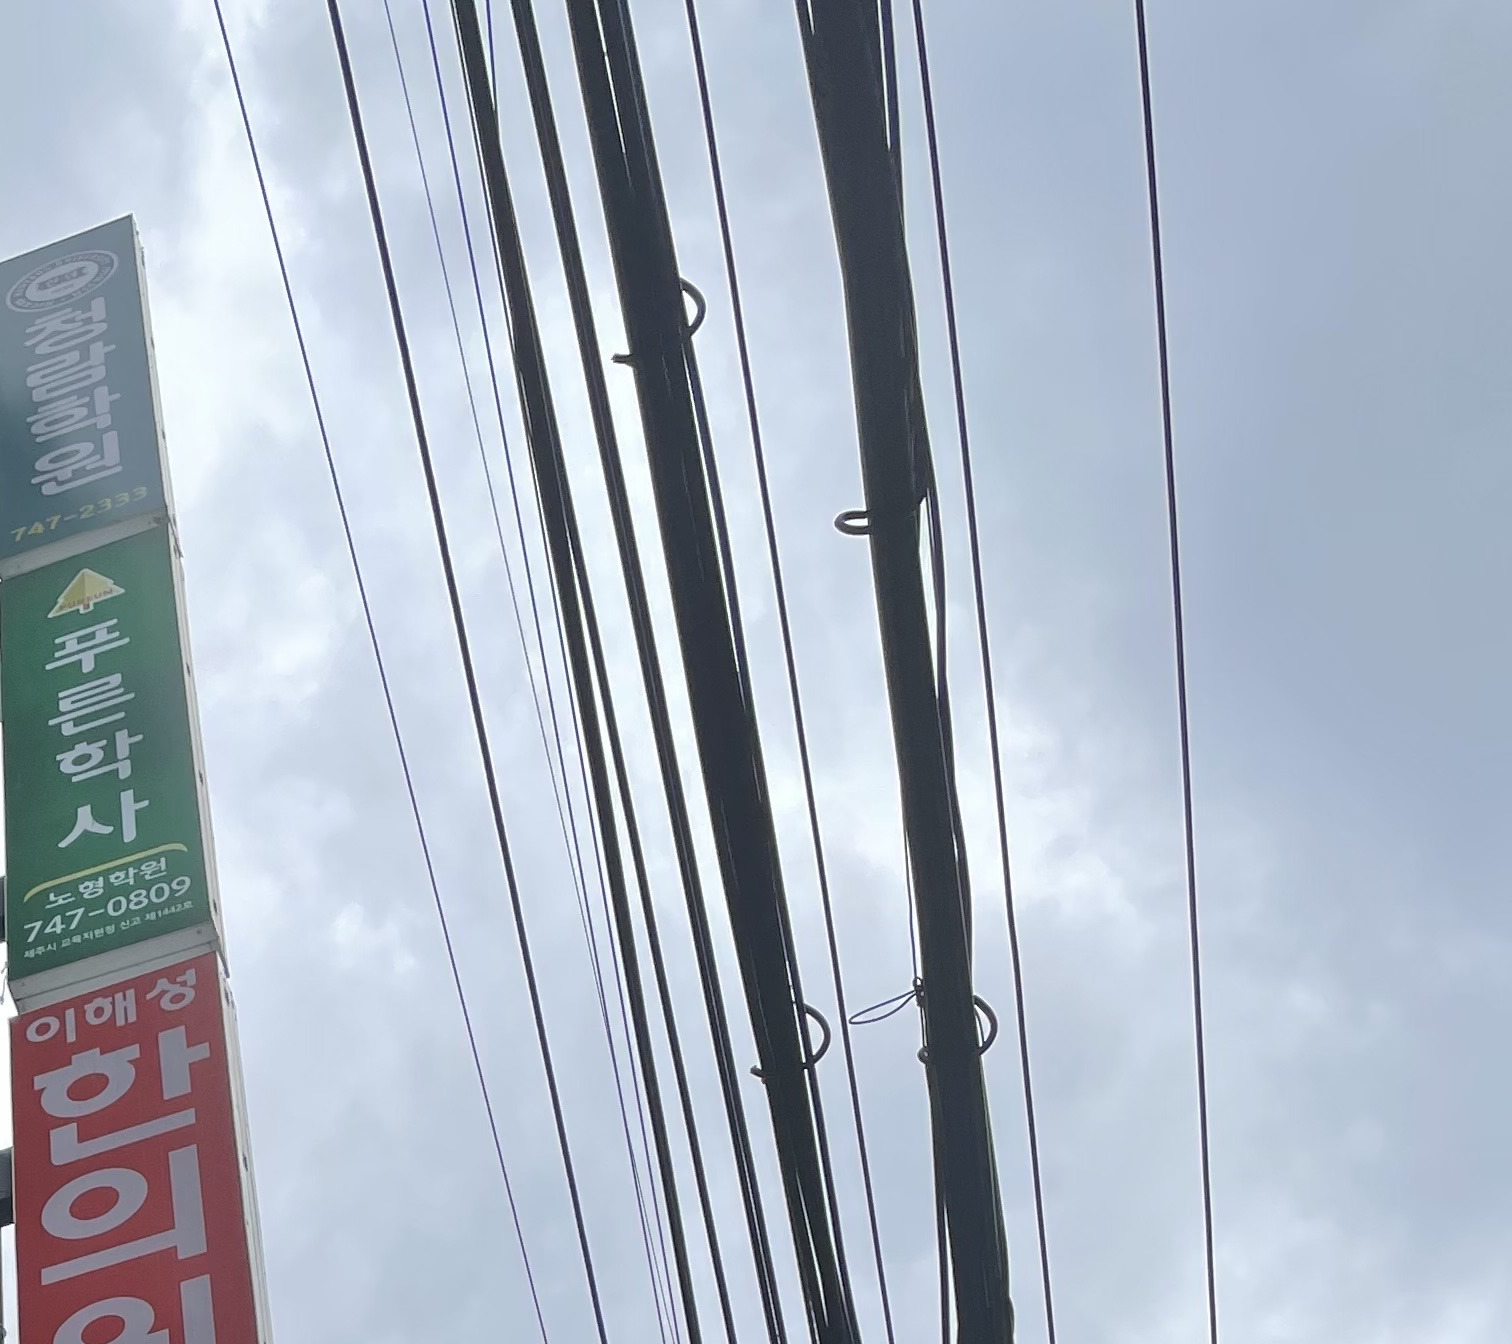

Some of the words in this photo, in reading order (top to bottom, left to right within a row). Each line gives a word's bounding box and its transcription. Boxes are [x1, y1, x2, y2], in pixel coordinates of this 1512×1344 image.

[23, 296, 123, 496] 청람학원
[11, 486, 148, 542] 747-2333
[45, 618, 150, 848] 푸른학사
[23, 875, 192, 943] 747-0809
[44, 856, 168, 909] 노형학원
[25, 968, 197, 1044] 이해성
